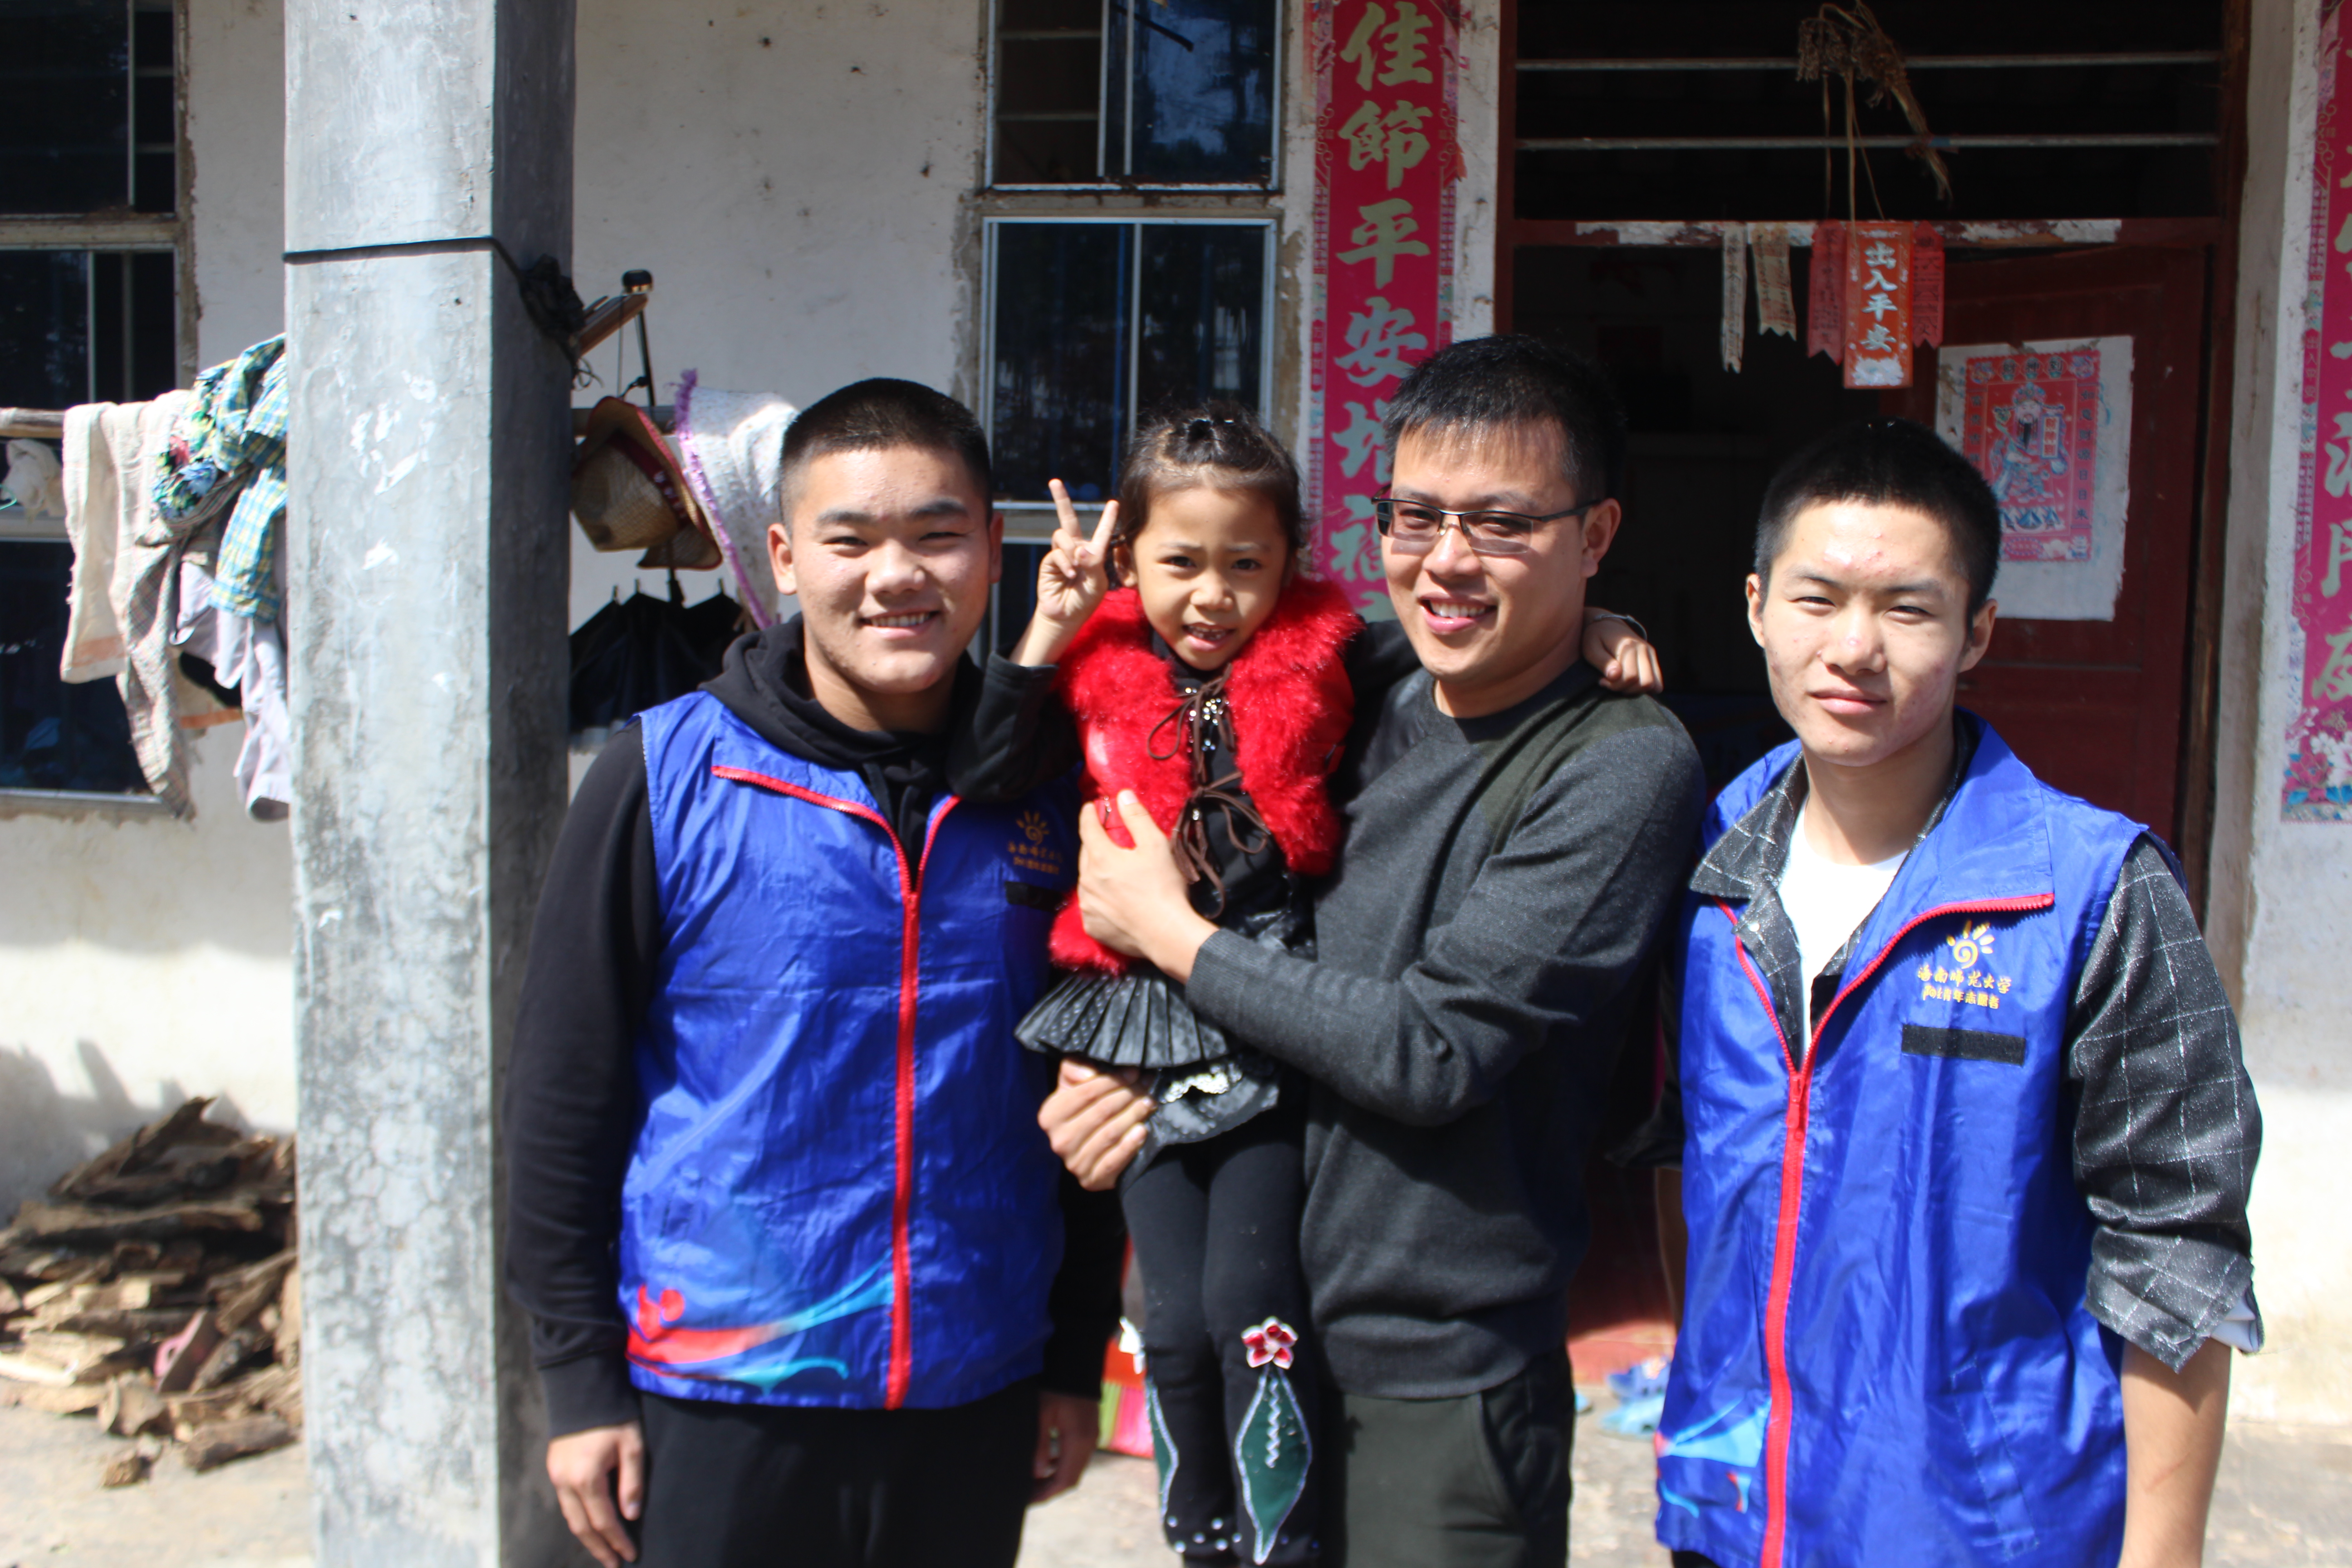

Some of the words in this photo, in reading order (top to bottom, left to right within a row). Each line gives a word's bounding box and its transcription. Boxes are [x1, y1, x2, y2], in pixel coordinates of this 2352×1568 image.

[1861, 241, 1898, 353] 出入平安
[1918, 965, 2012, 994] 海南师范大学
